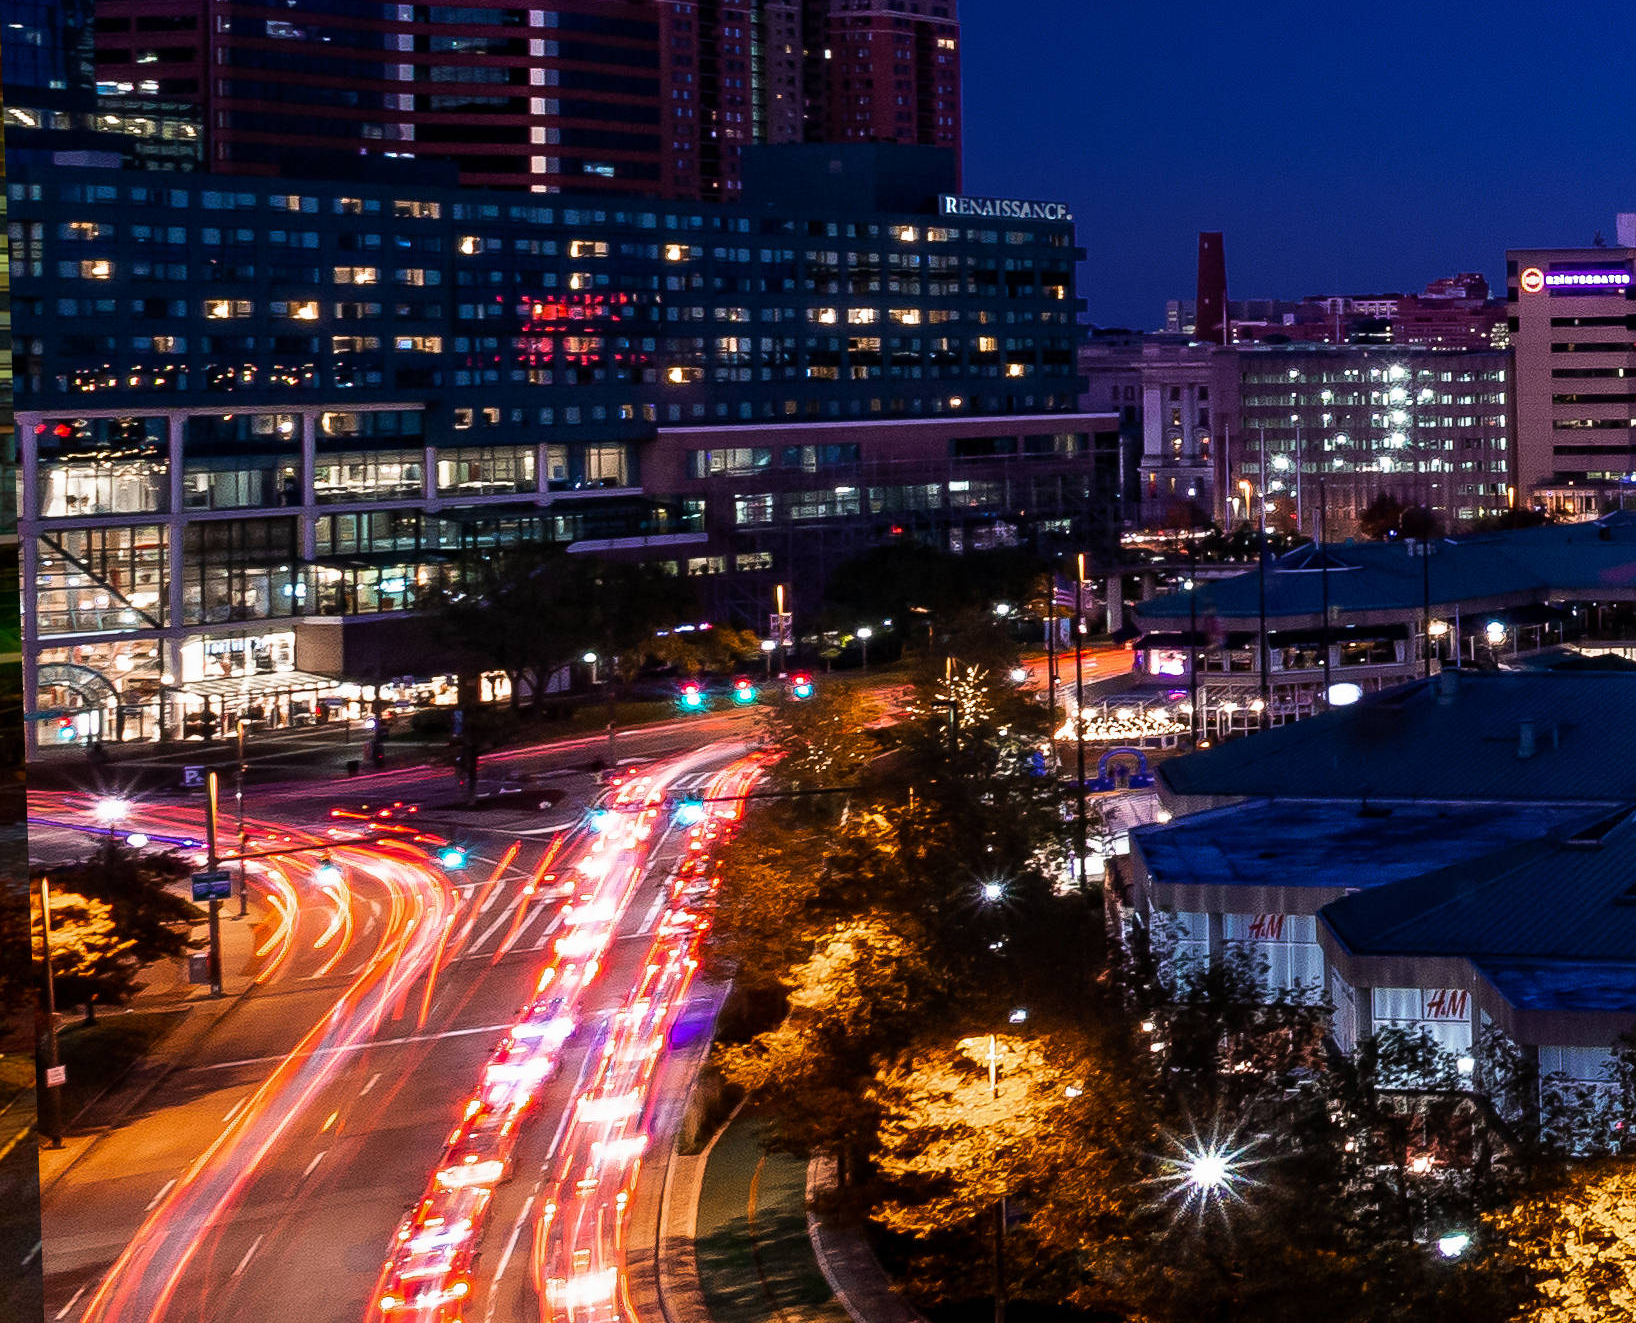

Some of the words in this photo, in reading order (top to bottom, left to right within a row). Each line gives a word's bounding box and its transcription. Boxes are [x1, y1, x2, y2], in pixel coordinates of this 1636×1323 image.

[945, 196, 1067, 219] RENAISSANCE
[1250, 913, 1284, 940] H&M
[1427, 989, 1468, 1019] H&M
